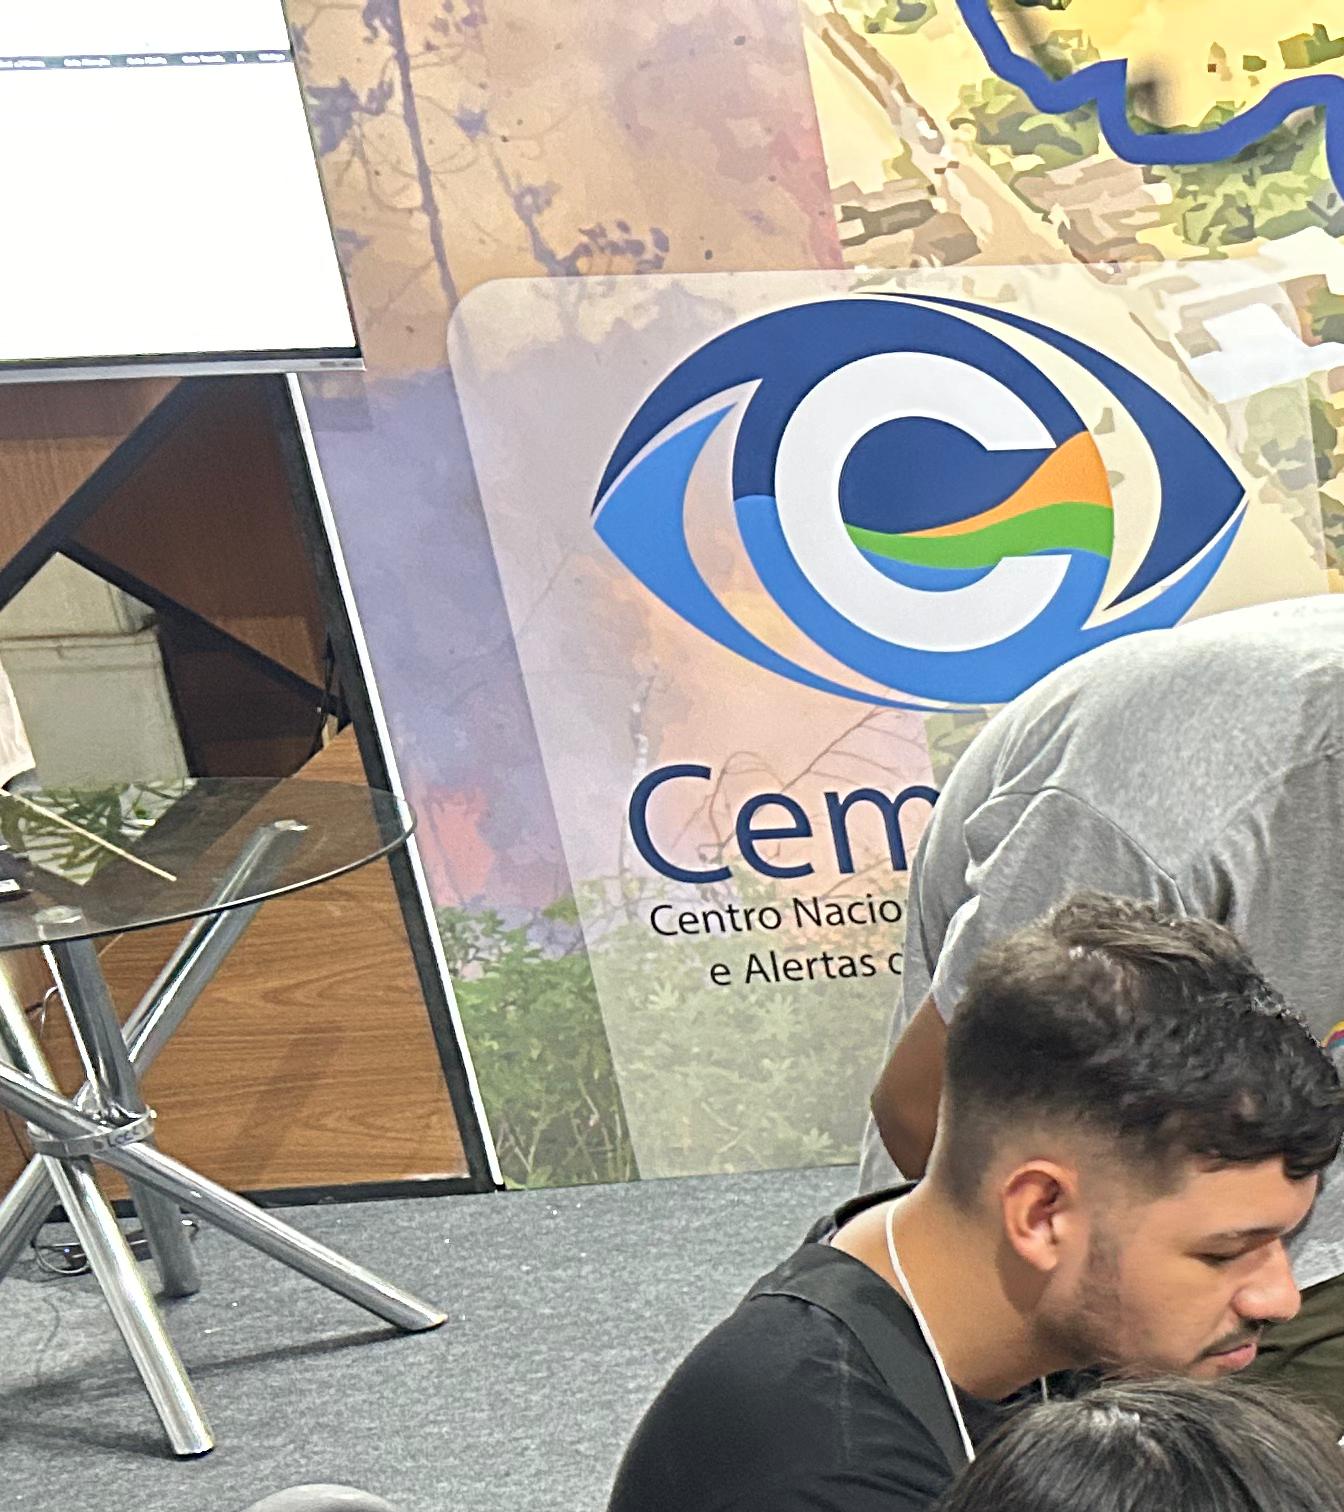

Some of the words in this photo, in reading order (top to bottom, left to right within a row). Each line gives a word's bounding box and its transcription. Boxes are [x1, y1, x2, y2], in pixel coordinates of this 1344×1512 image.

[650, 902, 782, 938] Centro
[709, 958, 731, 986] e
[744, 948, 874, 985] Alertas
